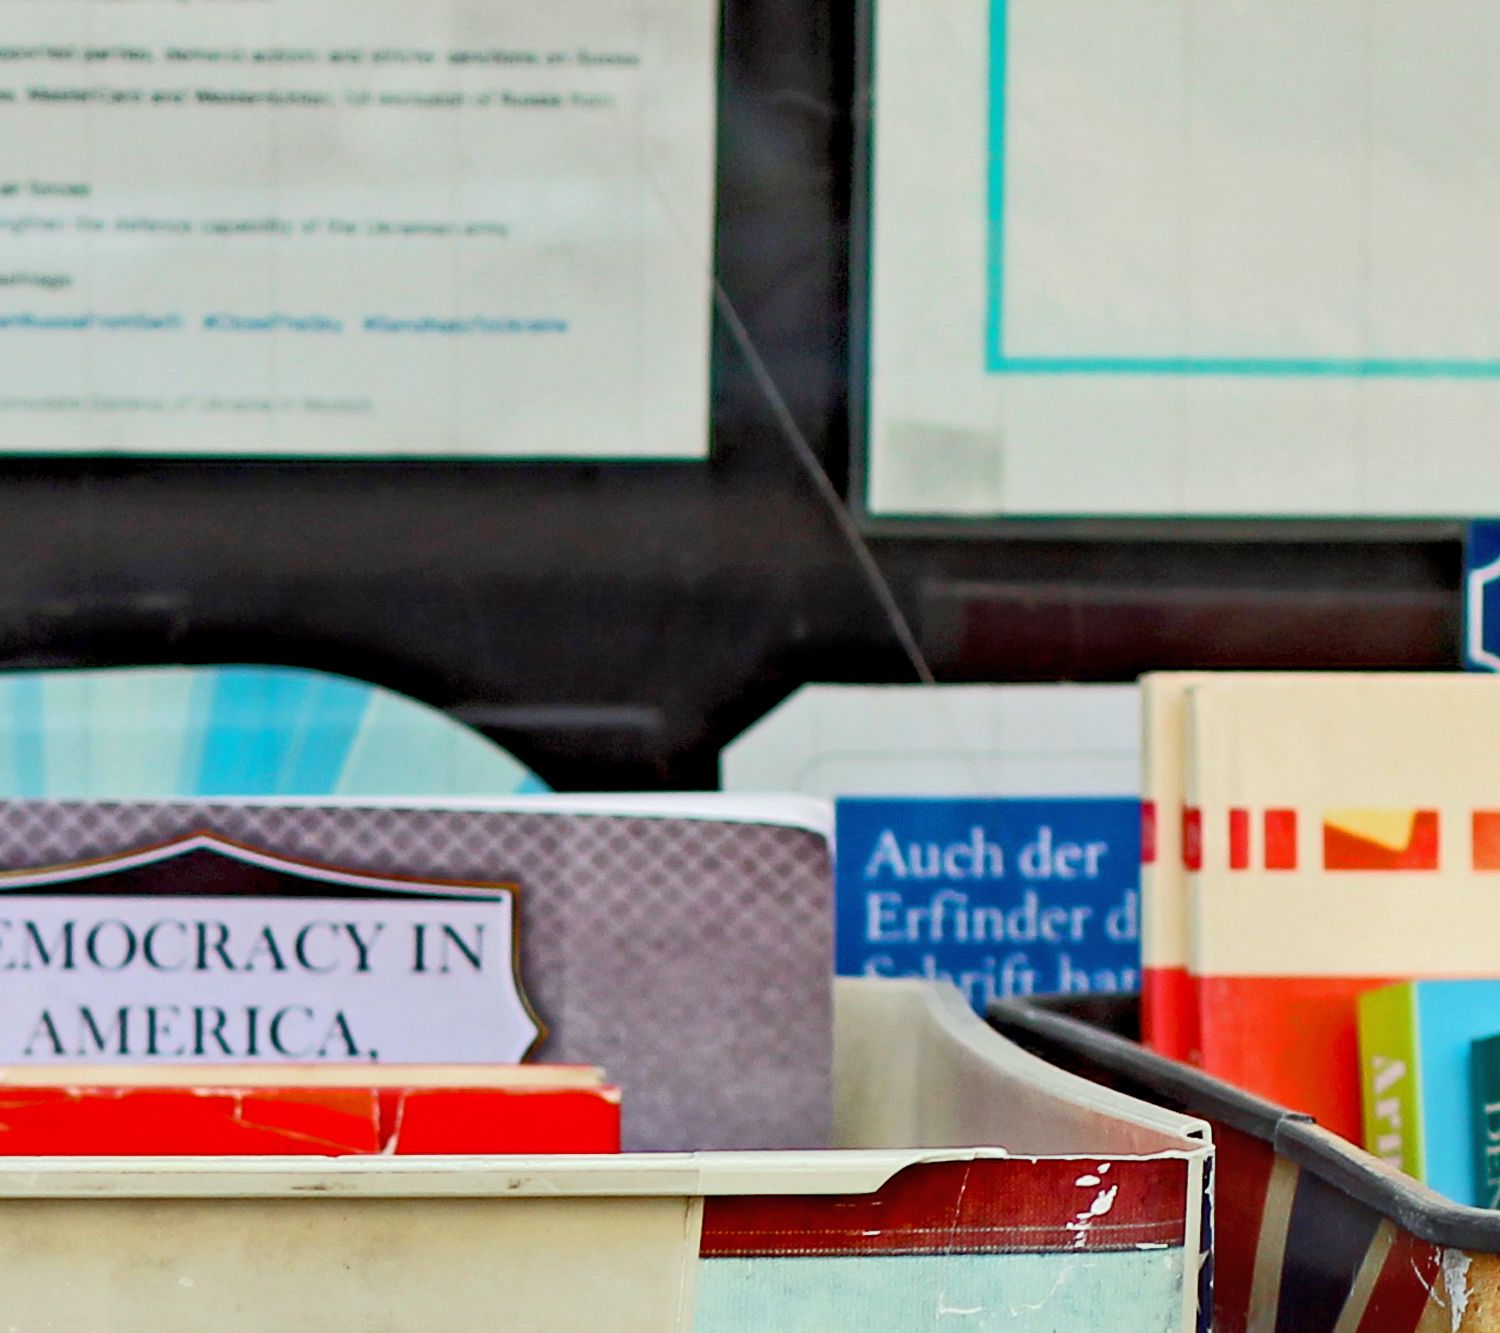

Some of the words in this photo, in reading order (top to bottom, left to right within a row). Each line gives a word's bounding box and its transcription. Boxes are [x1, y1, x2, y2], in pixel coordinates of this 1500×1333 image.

[864, 825, 1006, 880] Auch
[1018, 824, 1109, 880] der
[865, 888, 1094, 943] Erfinder
[410, 922, 488, 976] IN
[22, 1005, 382, 1063] AMERICA,
